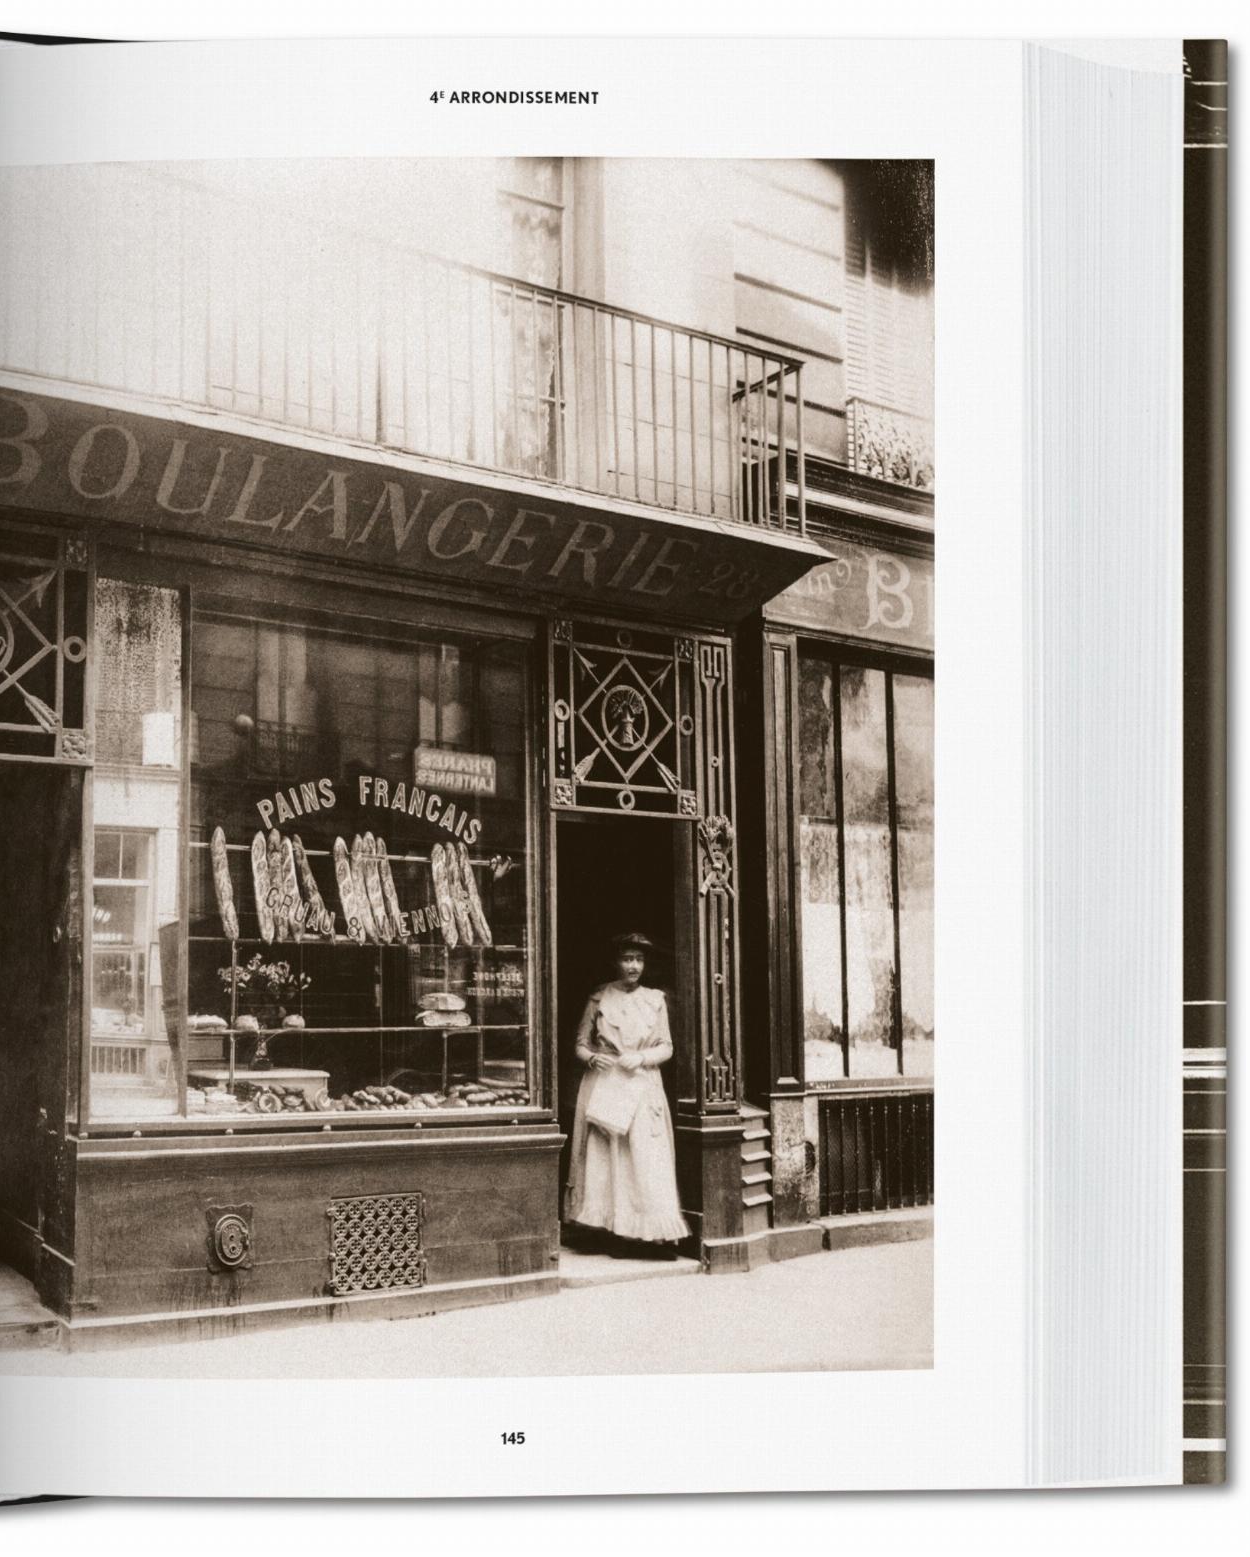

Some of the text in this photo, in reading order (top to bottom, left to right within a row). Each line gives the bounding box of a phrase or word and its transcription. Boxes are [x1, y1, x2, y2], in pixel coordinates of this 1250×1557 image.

[448, 90, 599, 105] ARRONDISSEMENT
[256, 775, 482, 845] PAINS FRANCAIS
[265, 886, 337, 935] GRUAU
[347, 916, 363, 938] &
[500, 1431, 526, 1446] 145
